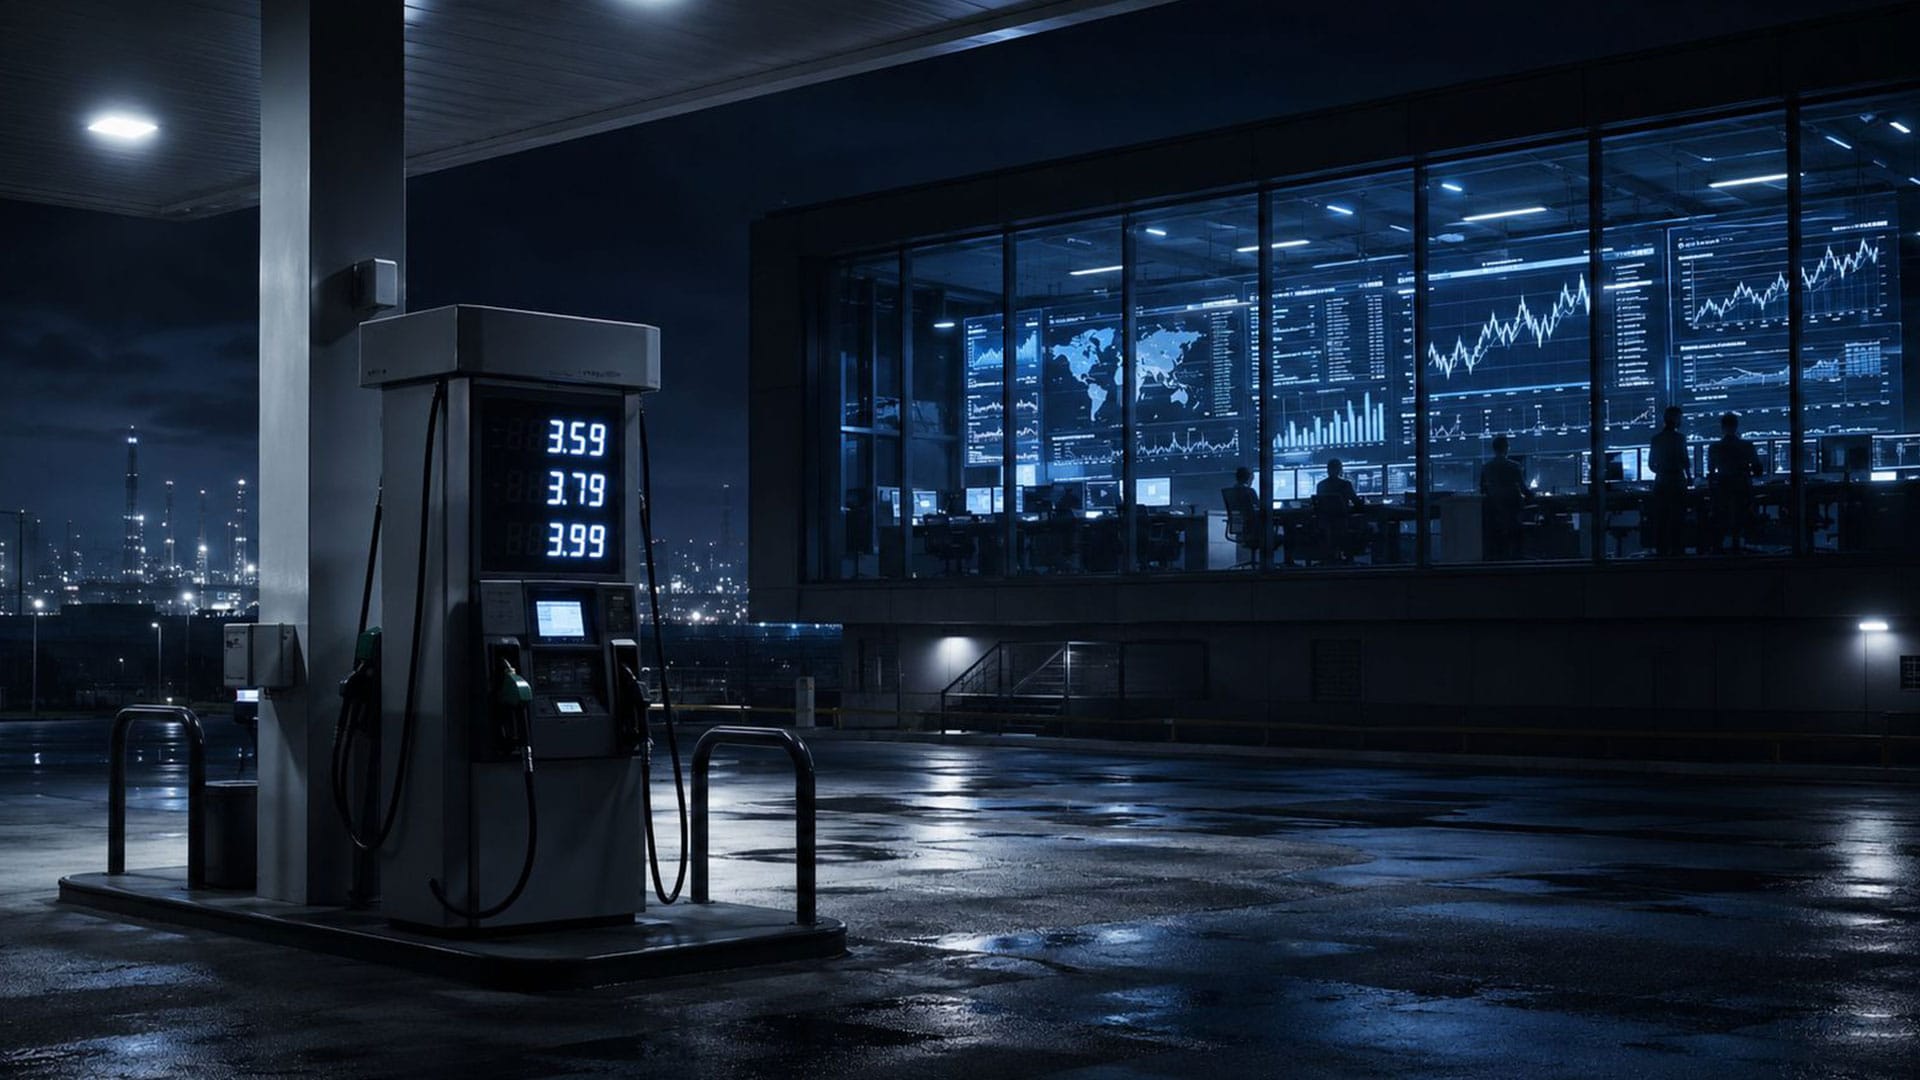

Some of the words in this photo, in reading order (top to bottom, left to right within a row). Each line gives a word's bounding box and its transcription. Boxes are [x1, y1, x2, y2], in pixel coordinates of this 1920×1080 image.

[547, 419, 605, 456] 3.59
[547, 471, 605, 507] 3.79
[547, 522, 605, 558] 3.99
